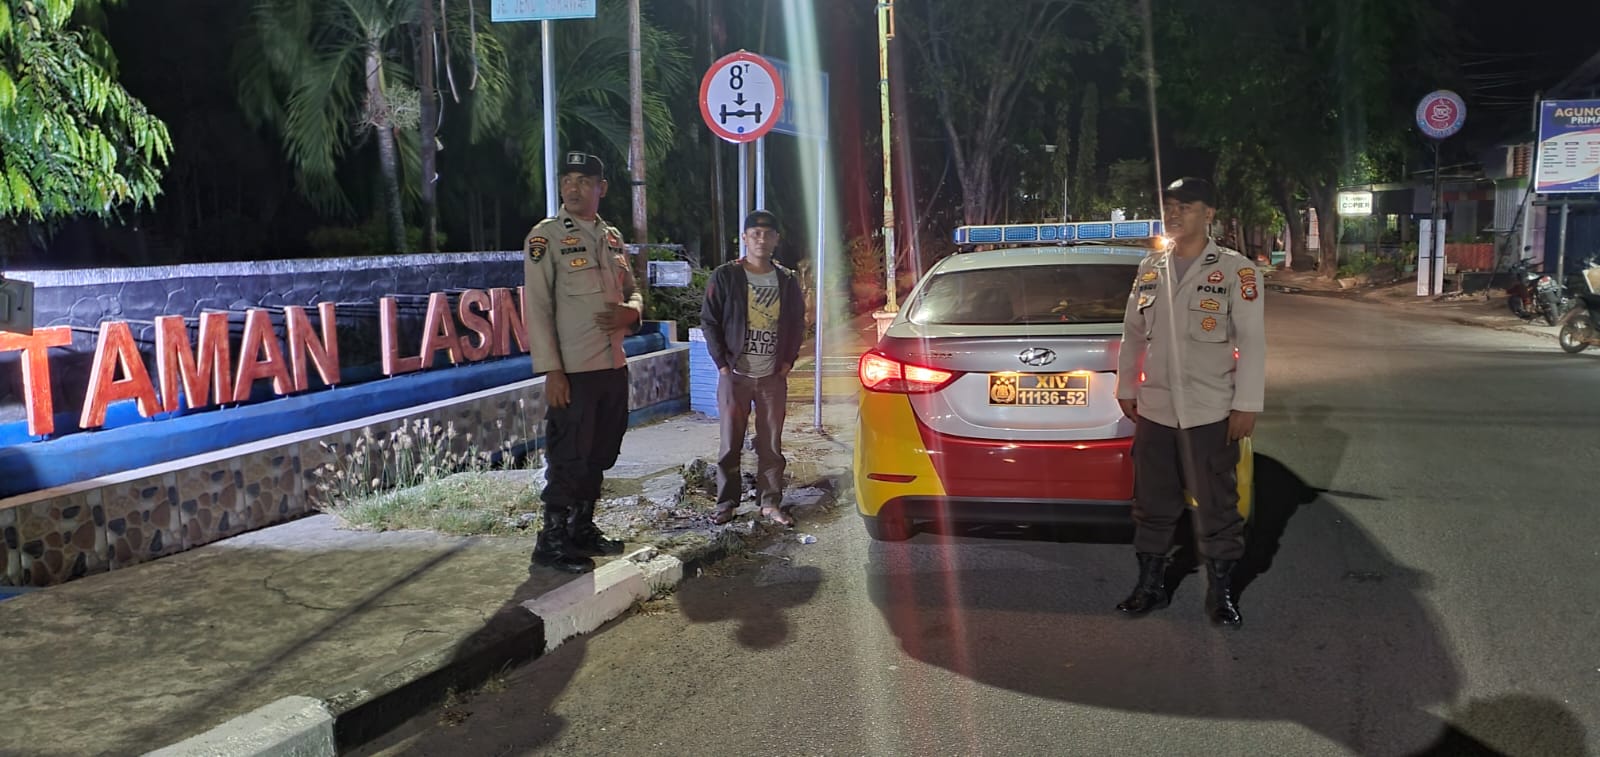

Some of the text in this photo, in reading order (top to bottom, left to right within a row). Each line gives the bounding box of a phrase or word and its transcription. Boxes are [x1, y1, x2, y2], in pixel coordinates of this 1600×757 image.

[1197, 285, 1227, 295] POLRI
[0, 302, 341, 437] TAMAN
[1036, 376, 1069, 389] XIV
[1019, 391, 1085, 405] 11136-52
